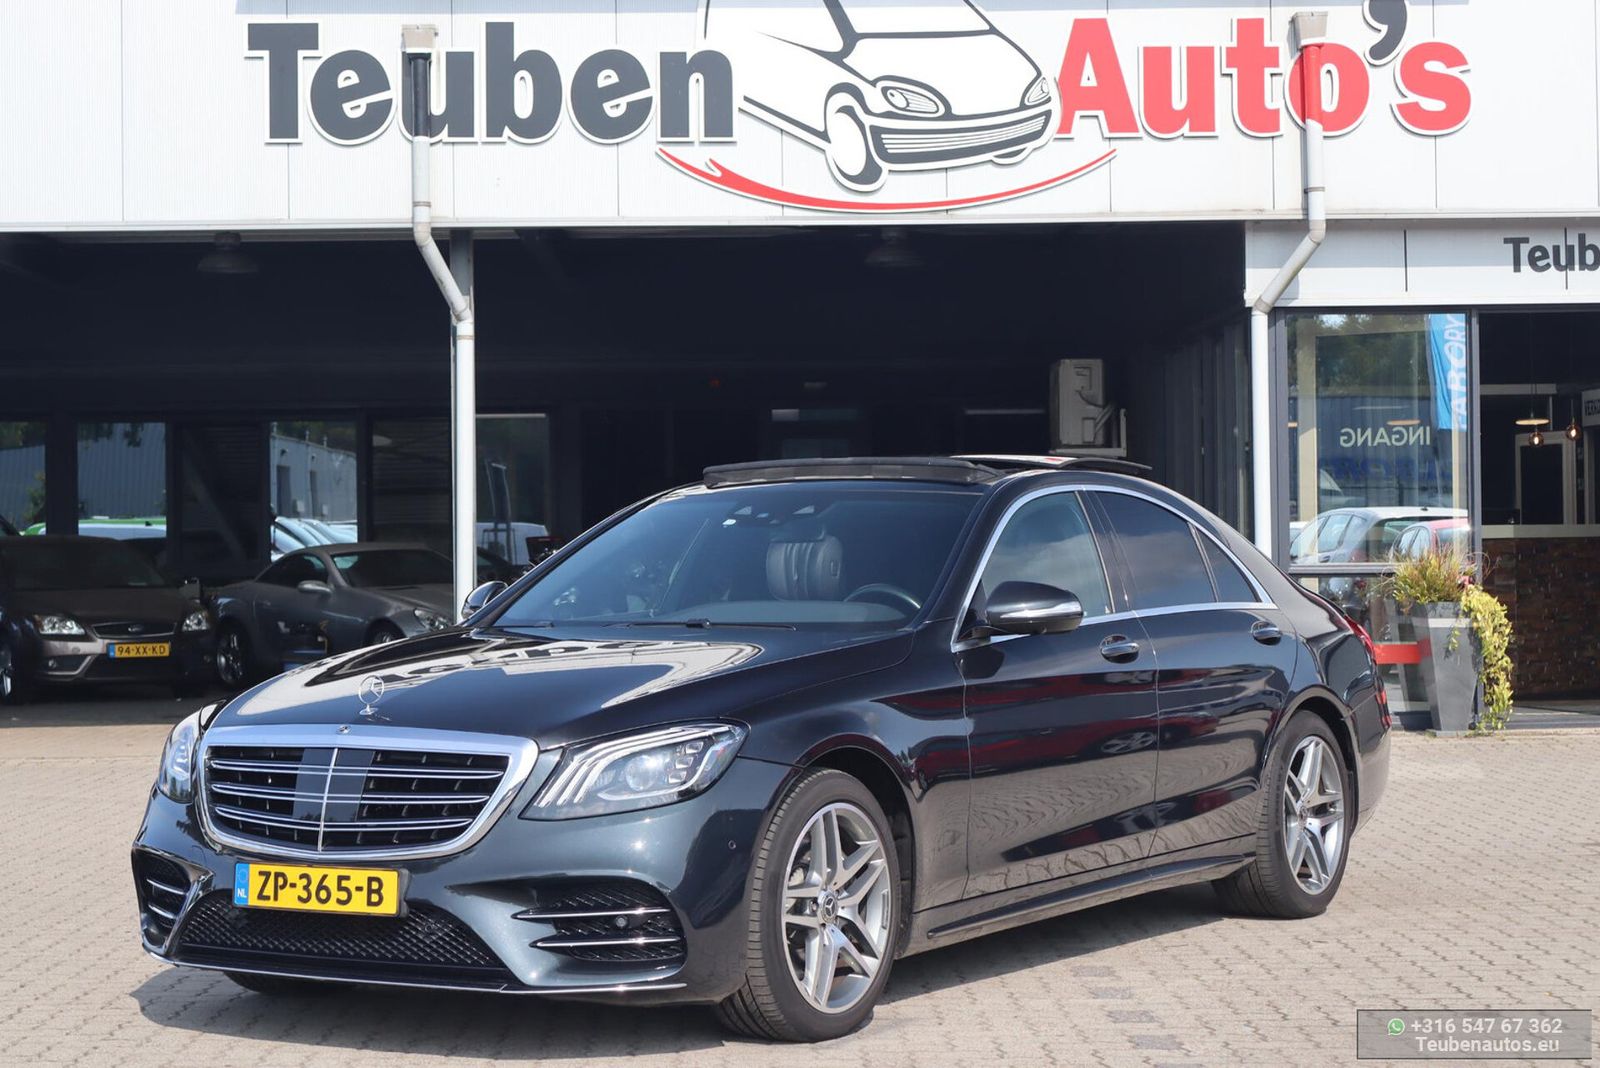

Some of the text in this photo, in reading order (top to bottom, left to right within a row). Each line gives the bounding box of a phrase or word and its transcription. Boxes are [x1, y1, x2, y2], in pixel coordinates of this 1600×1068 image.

[247, 0, 1472, 141] Teuben Auto's
[1503, 233, 1600, 273] Teub
[237, 888, 248, 899] NL
[256, 870, 384, 908] ZP-365-B
